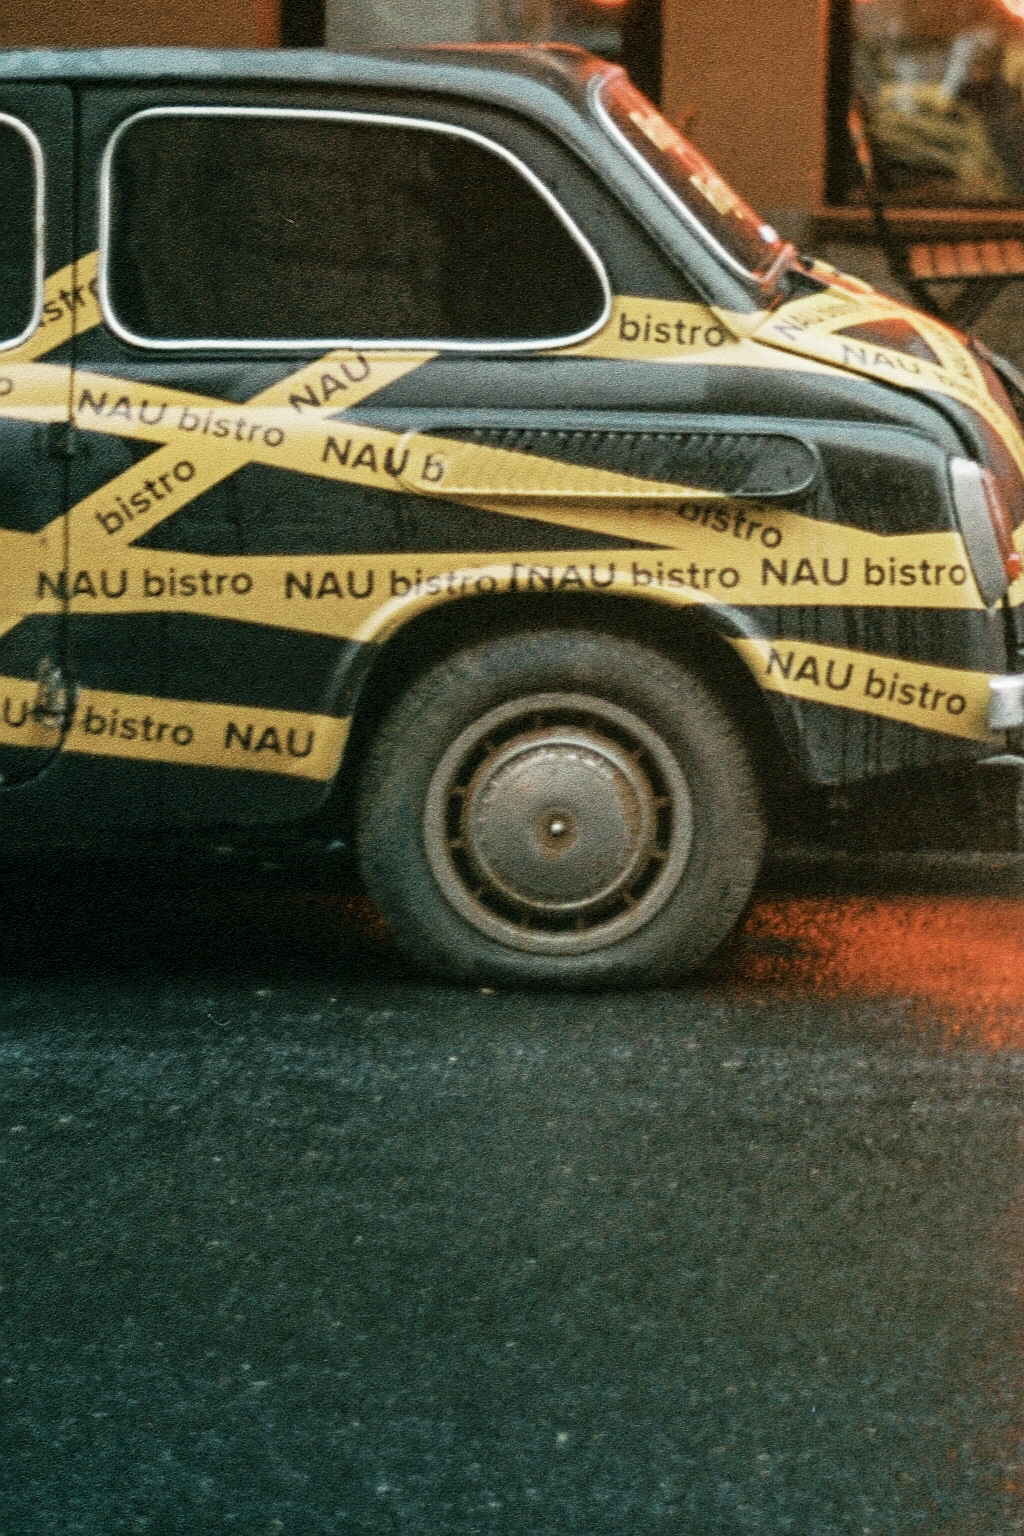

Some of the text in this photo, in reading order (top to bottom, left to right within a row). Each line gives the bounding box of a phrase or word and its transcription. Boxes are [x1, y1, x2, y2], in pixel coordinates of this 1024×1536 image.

[619, 312, 725, 347] bistro
[77, 389, 286, 447] NAU bistro
[95, 354, 371, 536] bistro NAU
[322, 435, 410, 478] NAU
[35, 568, 254, 600] NAU bistro
[283, 569, 375, 600] NAU
[390, 568, 497, 599] bistro
[631, 562, 741, 590] bistro
[761, 556, 967, 587] NAU bistro
[766, 647, 967, 716] NAU bistro
[83, 706, 195, 748] bistro
[224, 721, 316, 759] NAU
